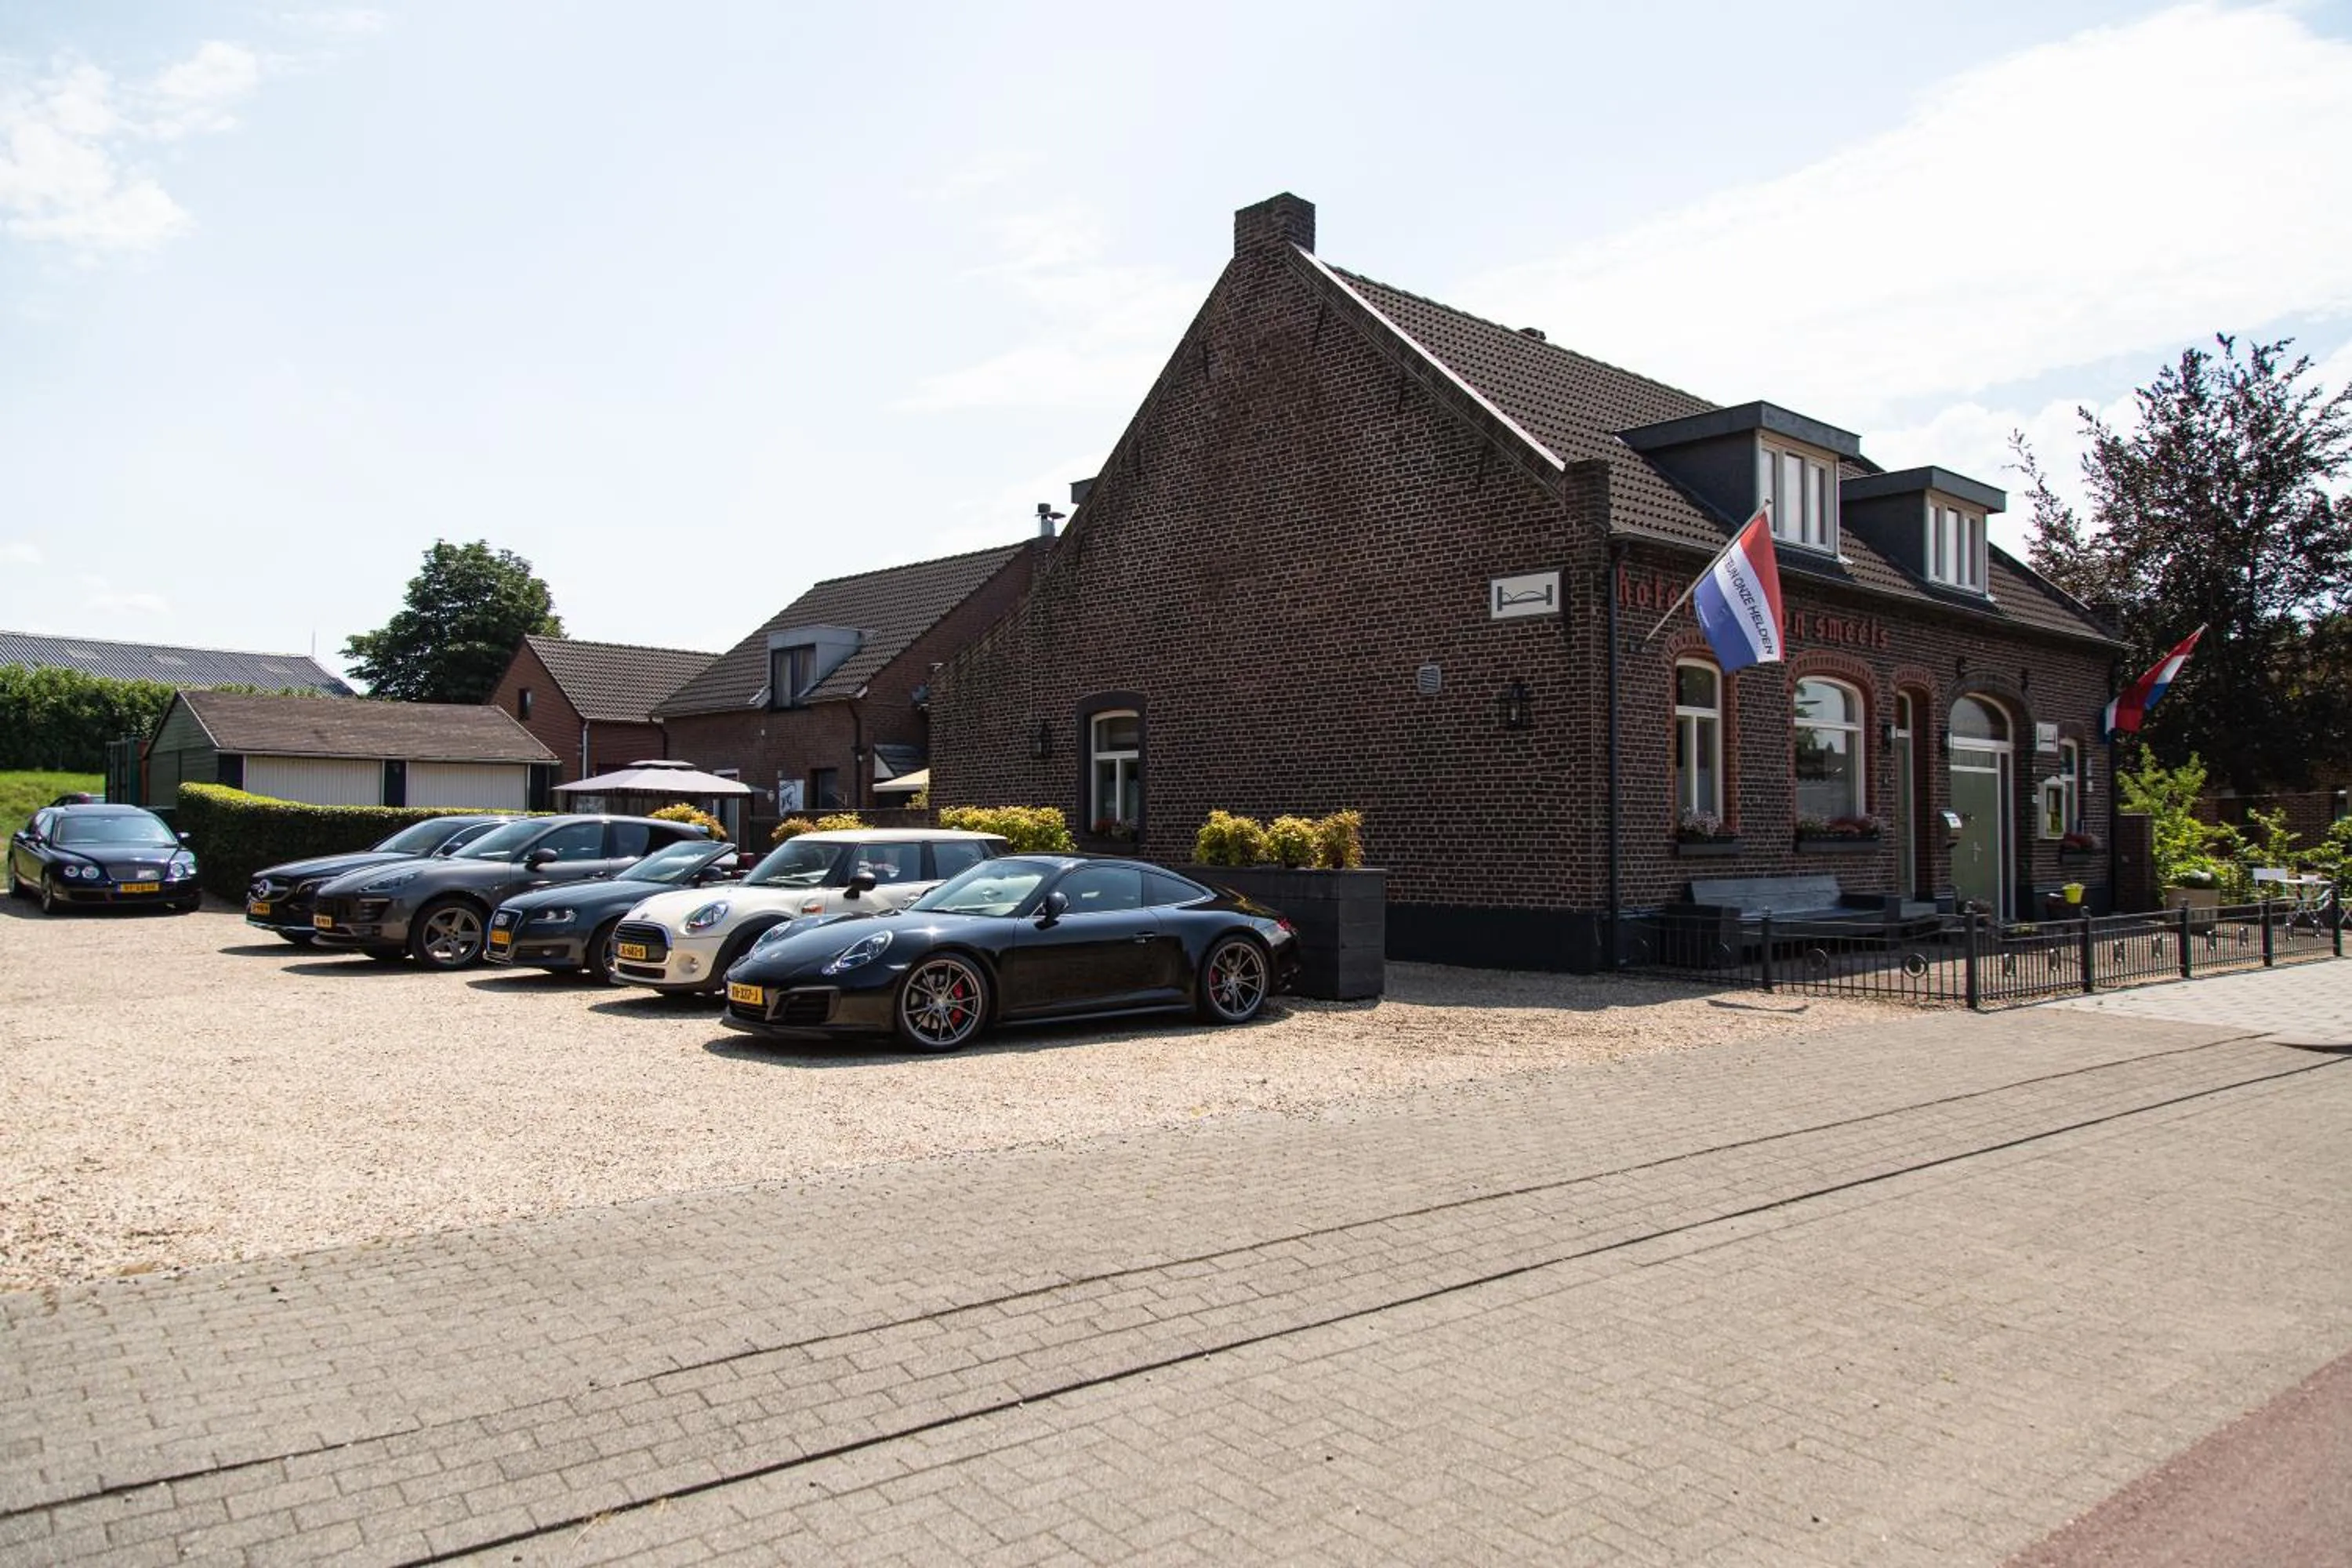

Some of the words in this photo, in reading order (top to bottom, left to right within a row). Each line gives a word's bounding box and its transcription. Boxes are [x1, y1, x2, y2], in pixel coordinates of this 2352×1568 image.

[1733, 578, 1755, 605] ONZE
[1748, 604, 1774, 655] HELDEN
[1816, 615, 1889, 649] smeets
